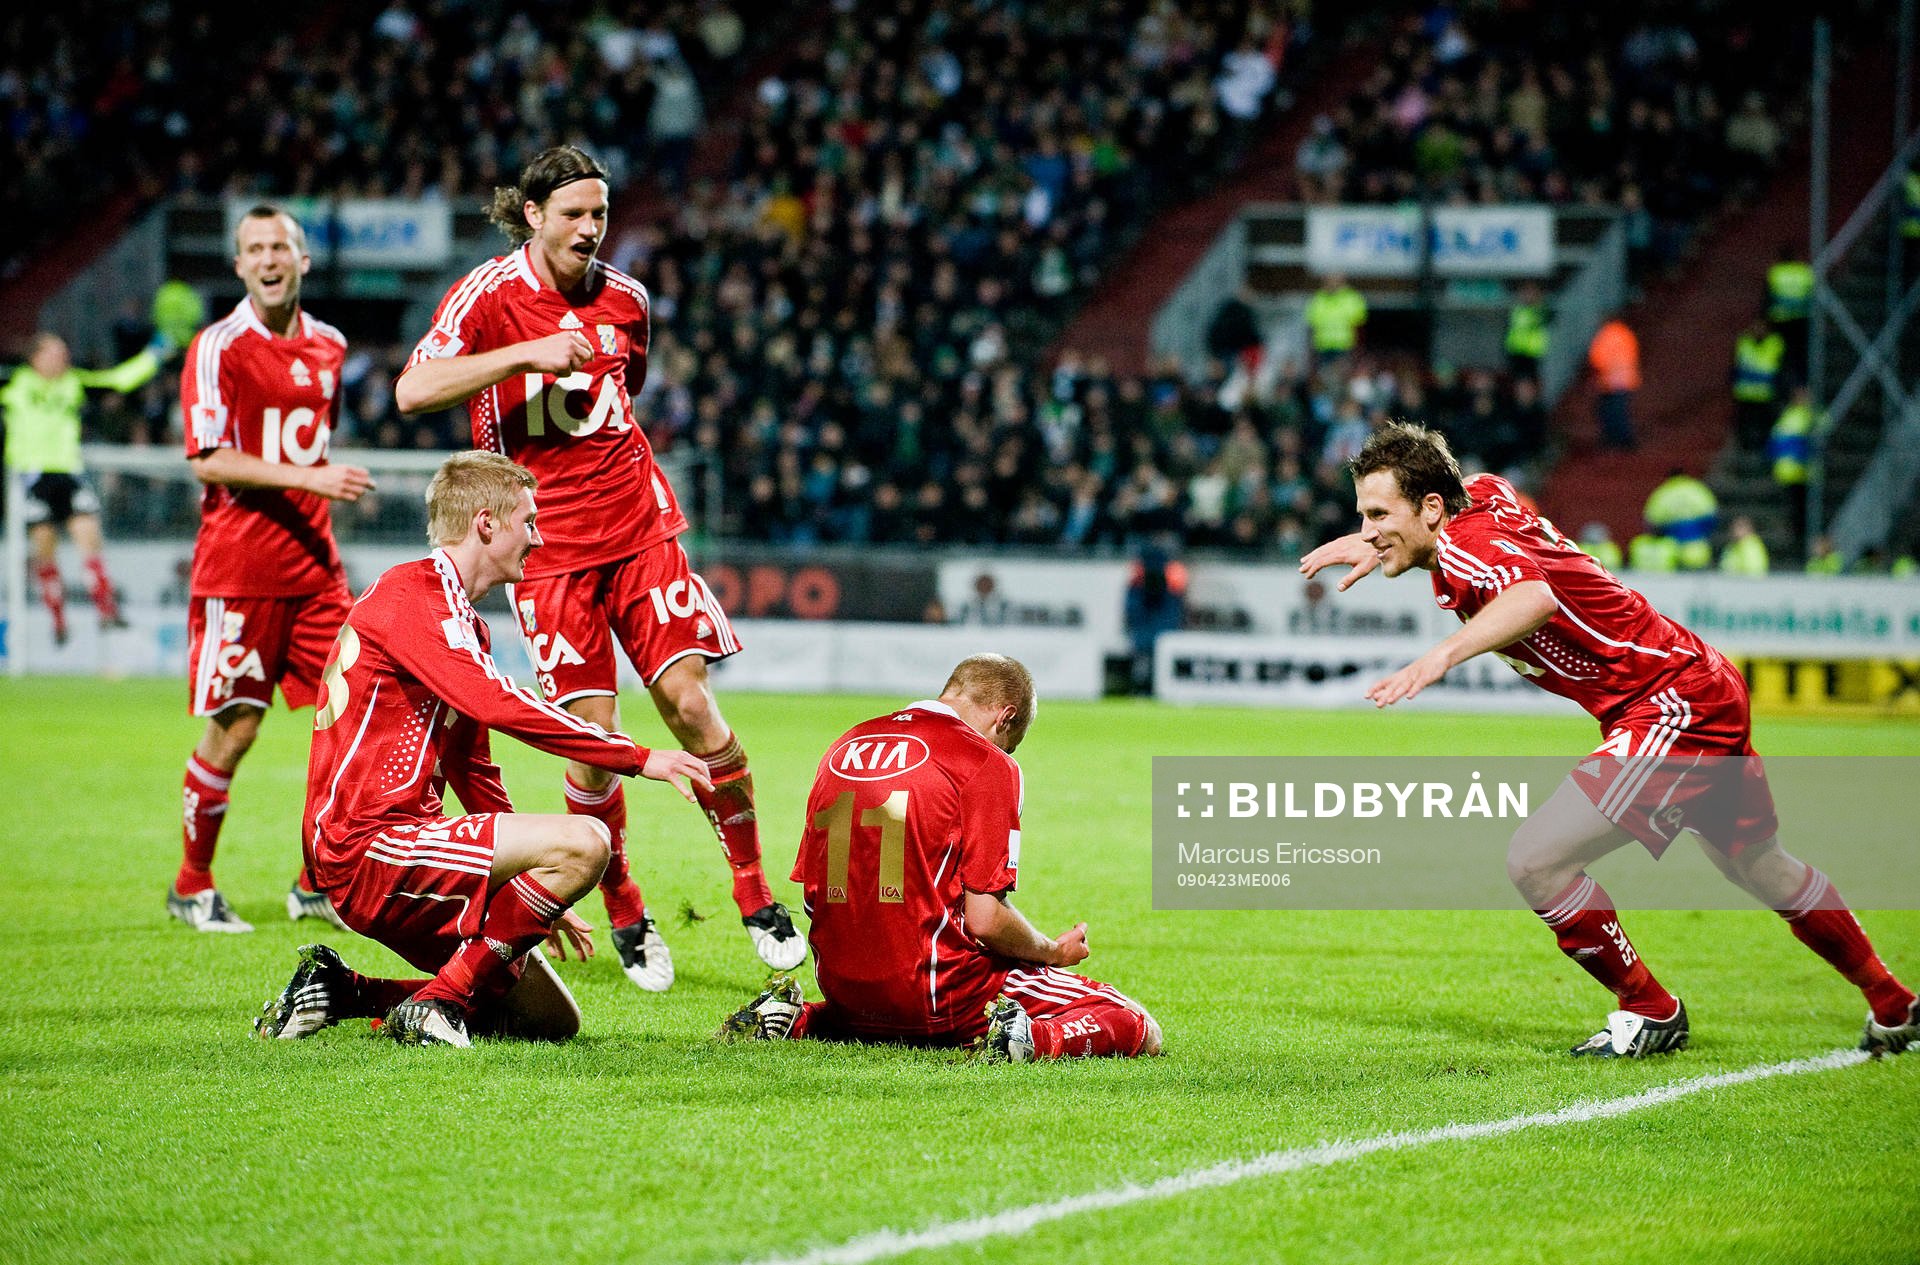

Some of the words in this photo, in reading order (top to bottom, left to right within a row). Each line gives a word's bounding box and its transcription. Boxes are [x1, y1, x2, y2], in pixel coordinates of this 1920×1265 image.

[525, 372, 632, 437] ICA
[650, 579, 706, 625] ICA
[217, 643, 266, 682] CA
[892, 713, 913, 722] ICA
[840, 741, 909, 770] KIA
[814, 790, 910, 903] 11
[828, 886, 847, 899] ICA
[881, 885, 902, 899] ICA
[1061, 1013, 1102, 1040] SKF
